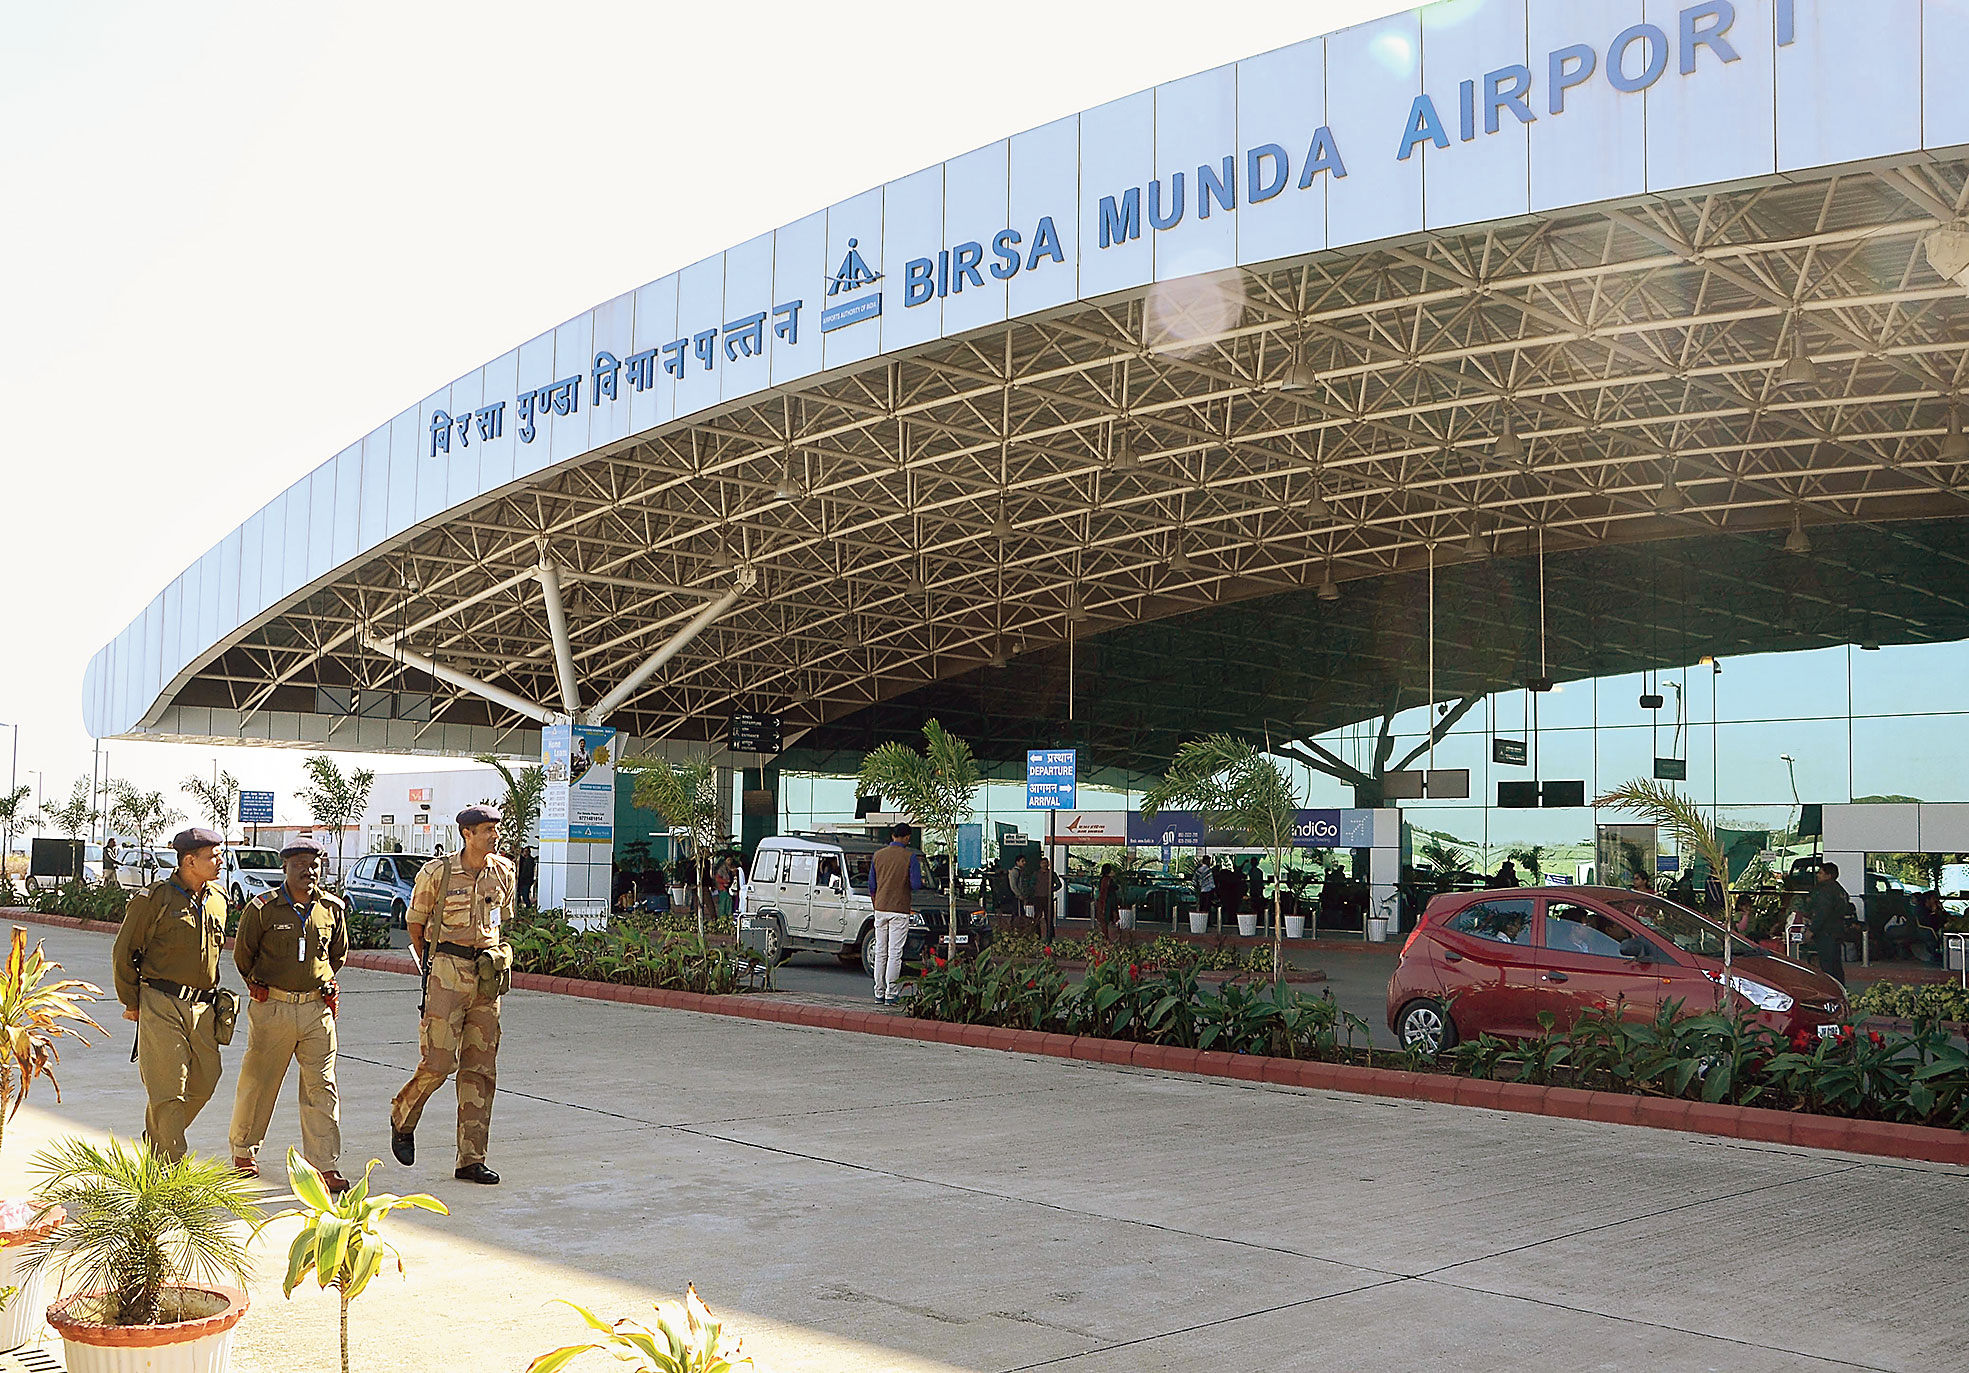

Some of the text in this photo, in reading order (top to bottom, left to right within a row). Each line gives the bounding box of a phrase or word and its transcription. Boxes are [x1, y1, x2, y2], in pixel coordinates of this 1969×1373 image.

[904, 216, 1065, 308] BIRSA
[1099, 126, 1348, 249] MUNDA
[430, 401, 505, 457] बिरसा
[517, 374, 582, 444] मुण्डा
[1047, 753, 1073, 763] प्रस्थान
[1030, 766, 1073, 776] DEPARTURE
[1029, 783, 1058, 793] आगमन
[1029, 796, 1060, 806] ARRIVAL
